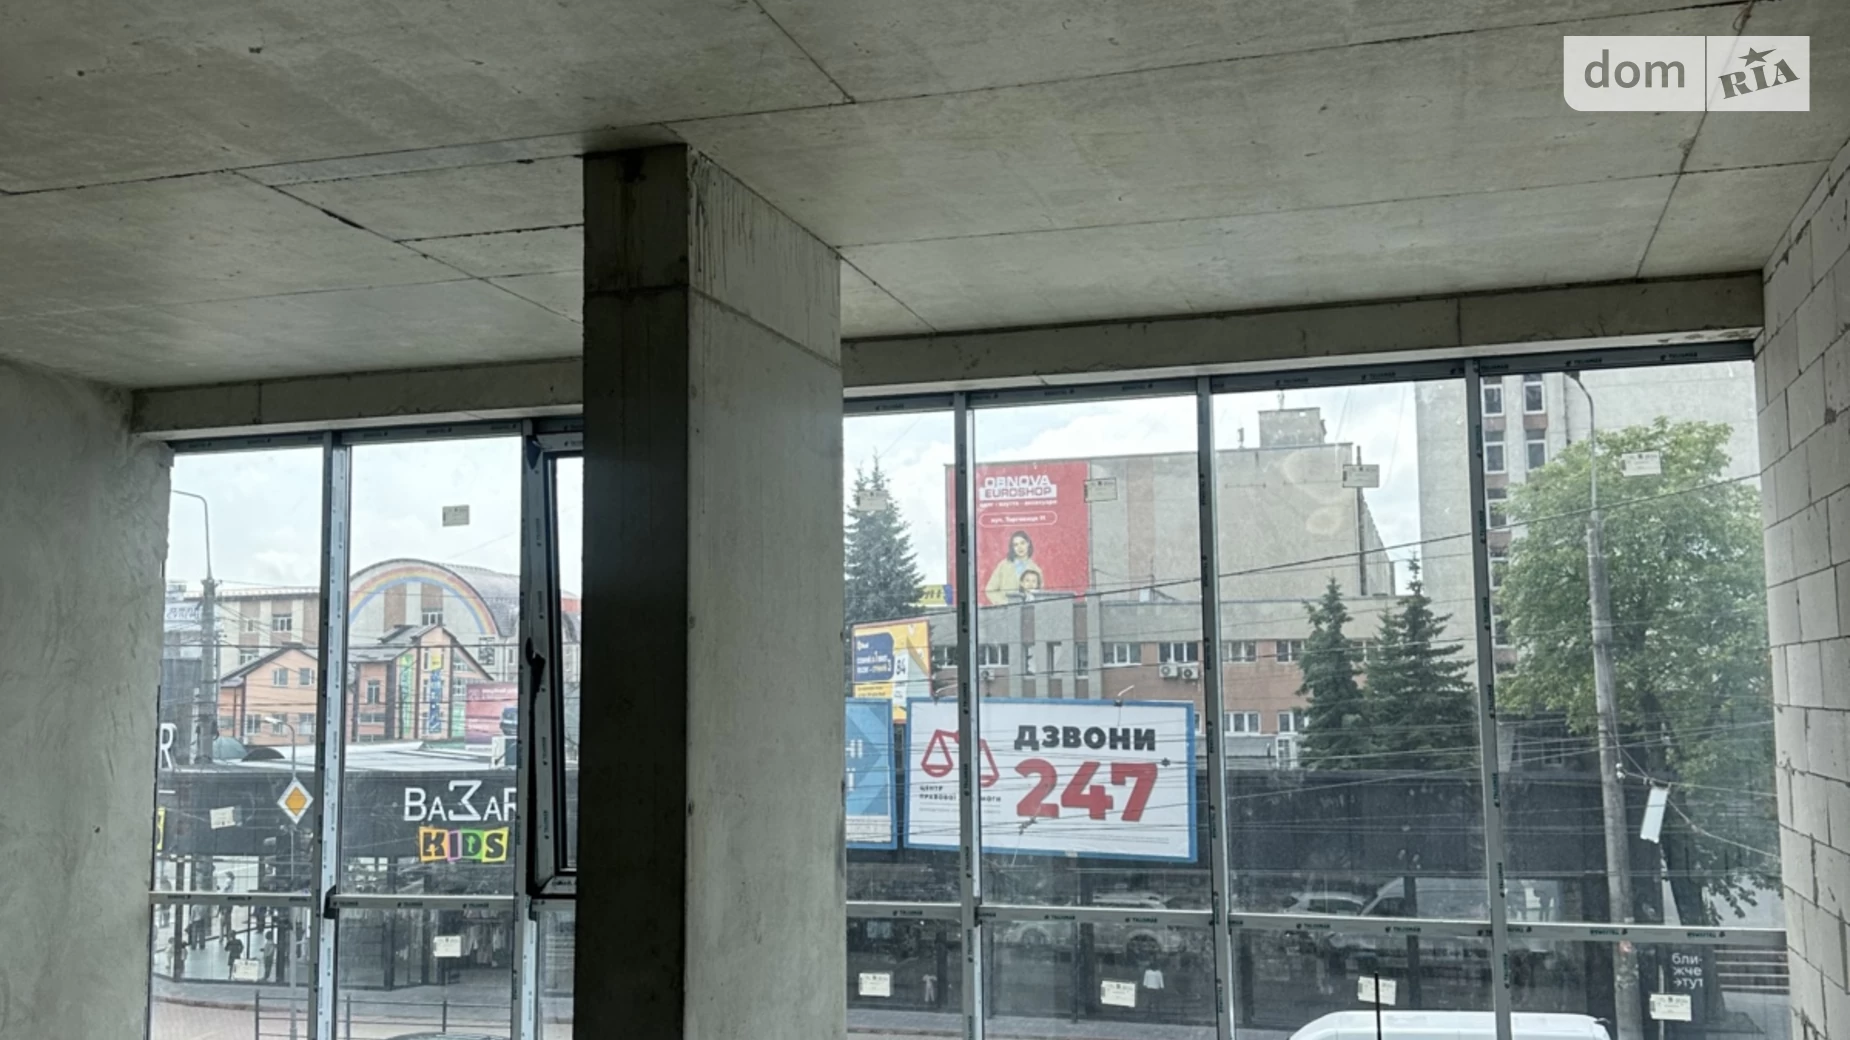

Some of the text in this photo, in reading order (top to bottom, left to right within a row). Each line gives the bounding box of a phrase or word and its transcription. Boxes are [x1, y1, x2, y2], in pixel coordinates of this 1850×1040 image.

[985, 475, 1052, 487] OBNOVA
[985, 487, 1052, 498] EUROSHOP
[1014, 725, 1155, 751] ДЗВОНИ
[421, 830, 505, 860] KIDS
[1671, 952, 1703, 965] бли-
[1672, 966, 1703, 977] жче
